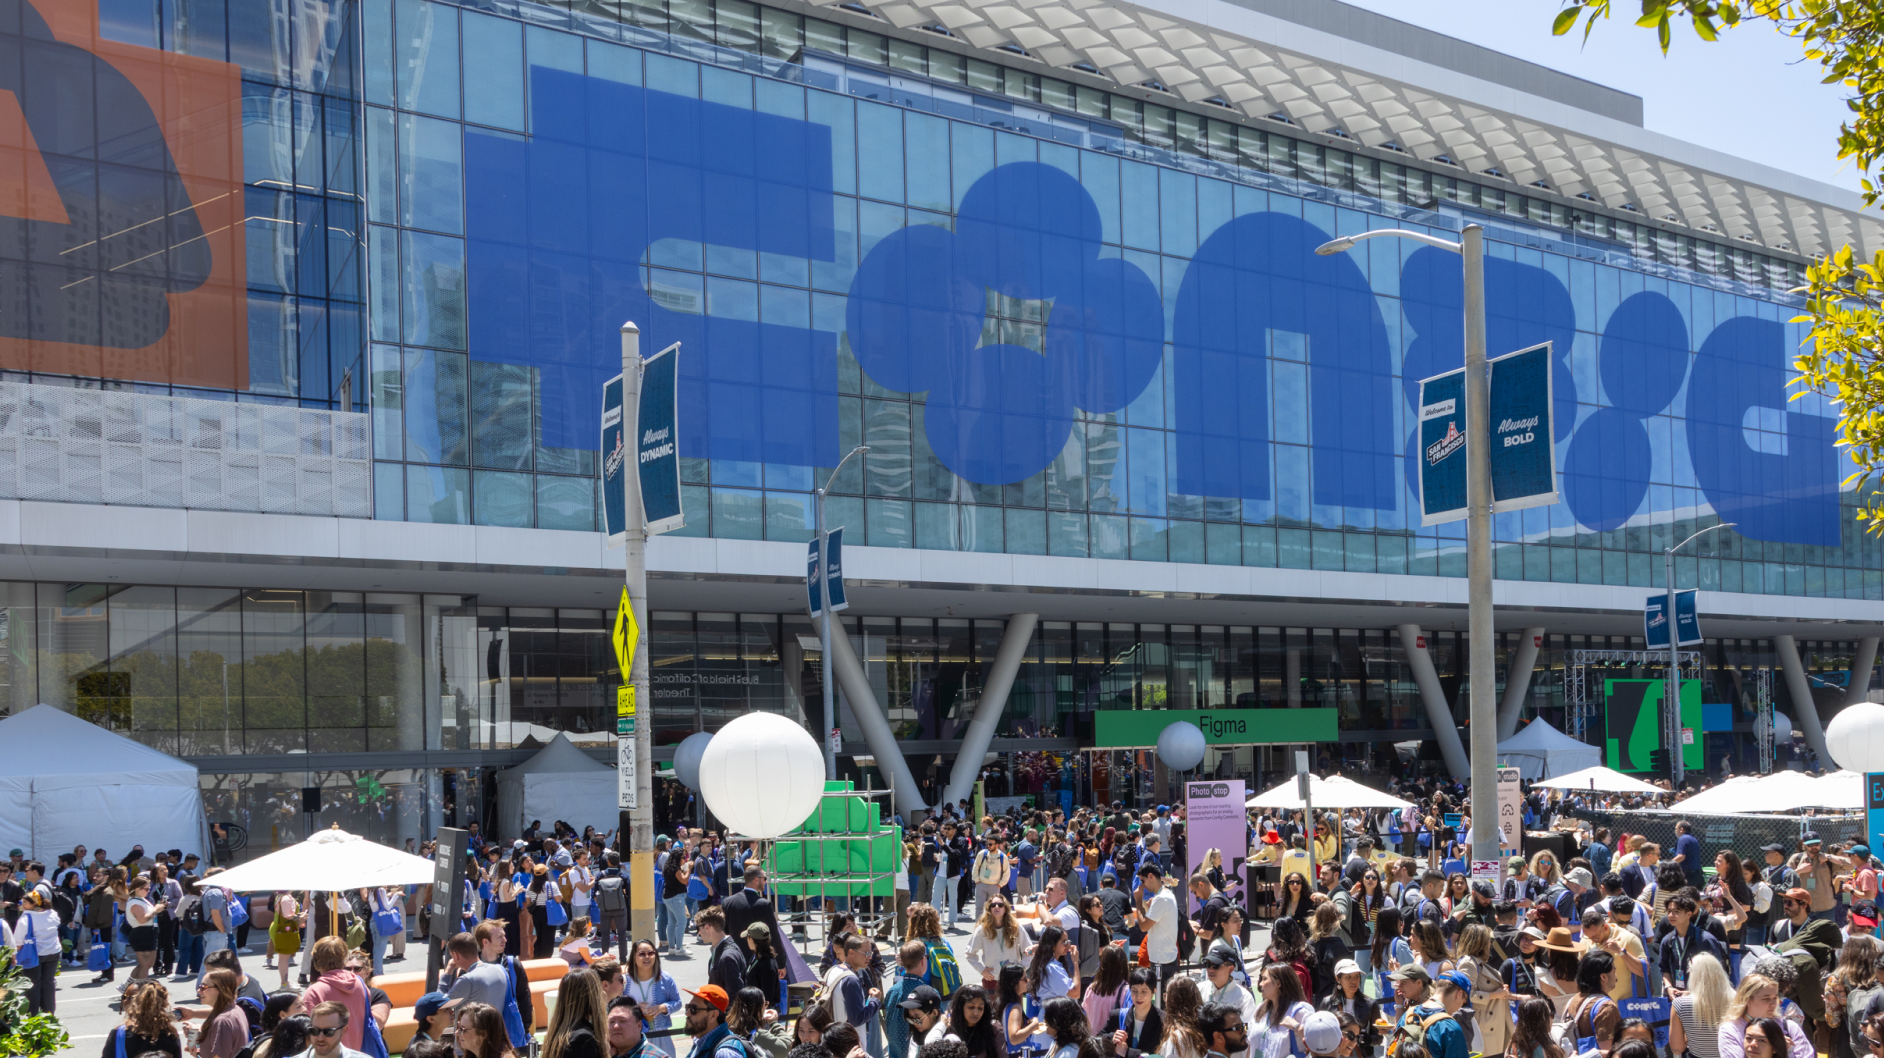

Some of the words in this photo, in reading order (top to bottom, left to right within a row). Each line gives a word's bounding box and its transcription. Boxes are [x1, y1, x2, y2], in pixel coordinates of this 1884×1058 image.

[1425, 408, 1446, 416] Welcome
[1498, 416, 1538, 434] Always
[643, 426, 669, 446] Always
[1504, 432, 1534, 447] BOLD
[641, 443, 674, 463] DYNAMIC
[1429, 444, 1442, 456] SAN
[1432, 436, 1464, 463] FRANCISCO
[620, 692, 634, 708] AHEAD
[1200, 716, 1246, 738] Figma
[621, 767, 634, 777] YIELD
[625, 780, 631, 790] TO
[1191, 787, 1210, 796] Photo
[1213, 787, 1228, 796] stop
[622, 793, 634, 803] PEDS
